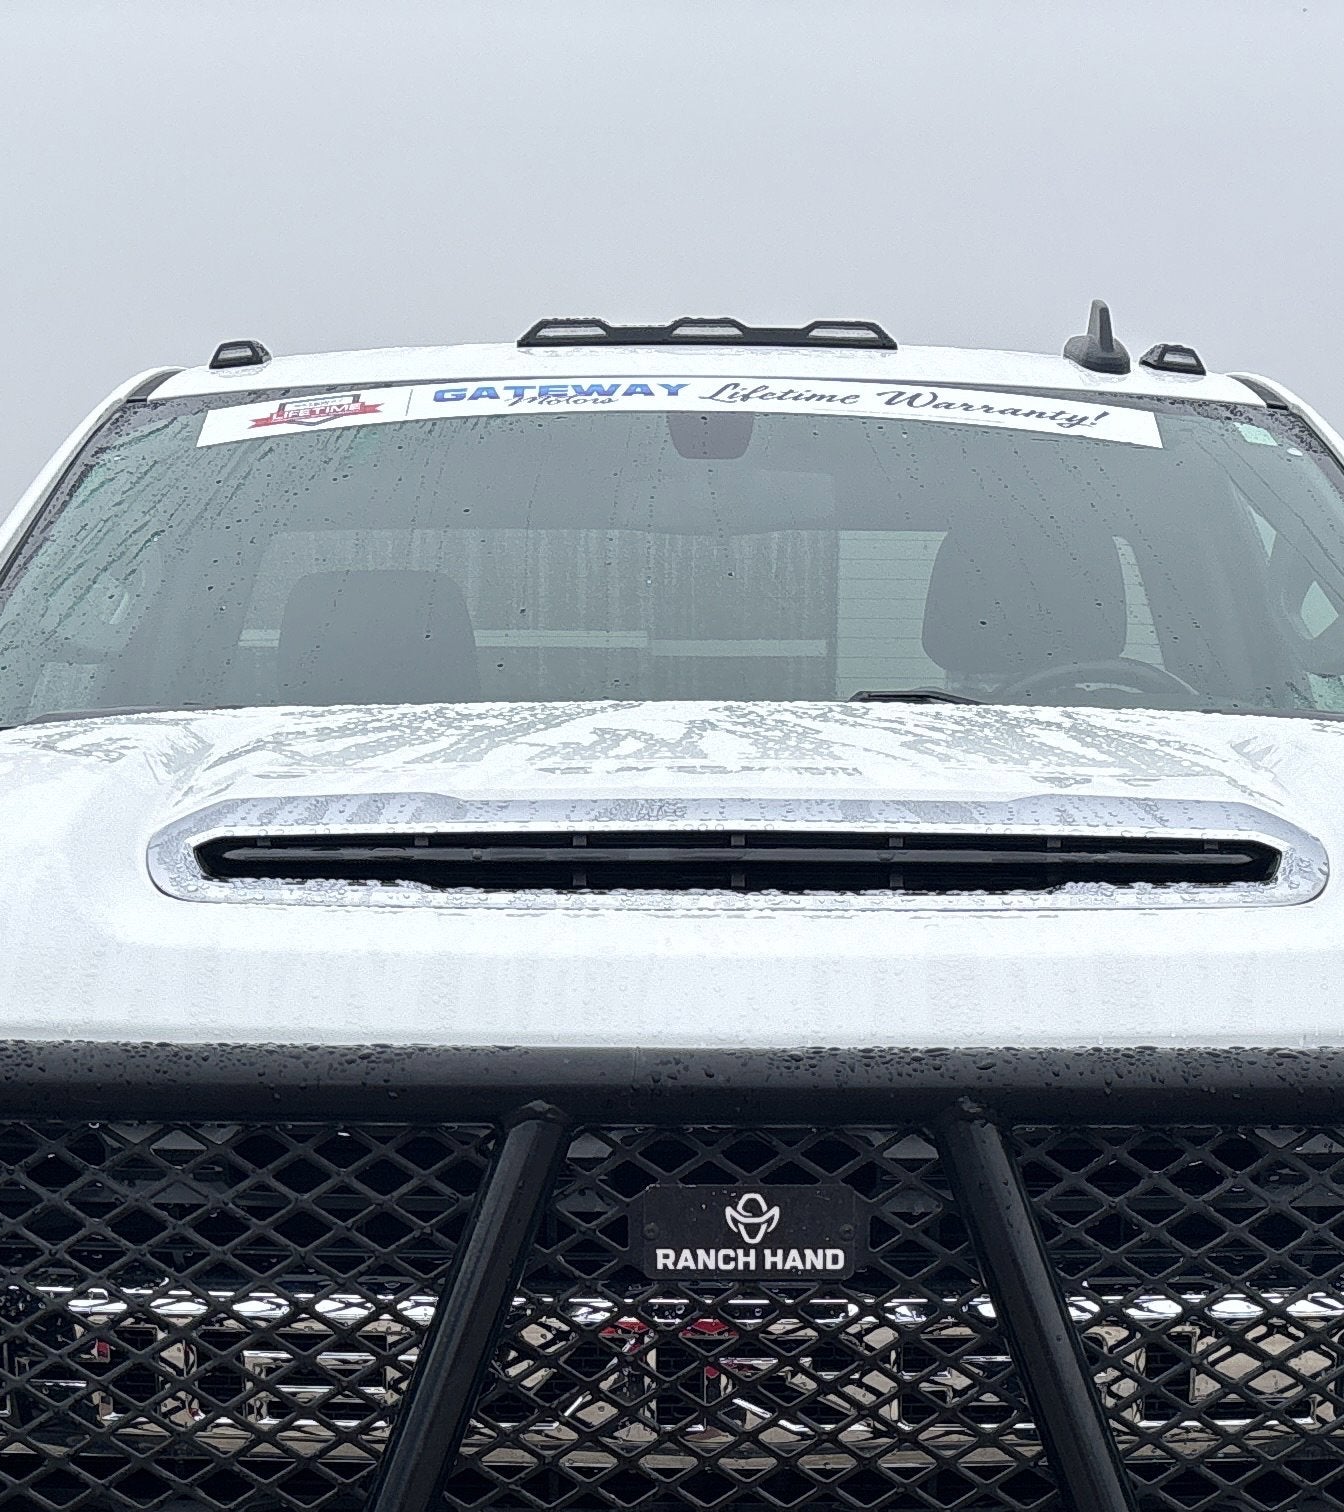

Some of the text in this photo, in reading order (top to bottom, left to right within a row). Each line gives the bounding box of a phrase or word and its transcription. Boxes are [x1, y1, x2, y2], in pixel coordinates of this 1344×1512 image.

[433, 384, 690, 402] GATEWAY
[504, 392, 619, 407] Motors
[272, 402, 362, 422] LIFETIME
[699, 383, 859, 405] Lifetime
[876, 391, 1110, 428] Warranty!
[656, 1248, 845, 1270] RANCH HAND
